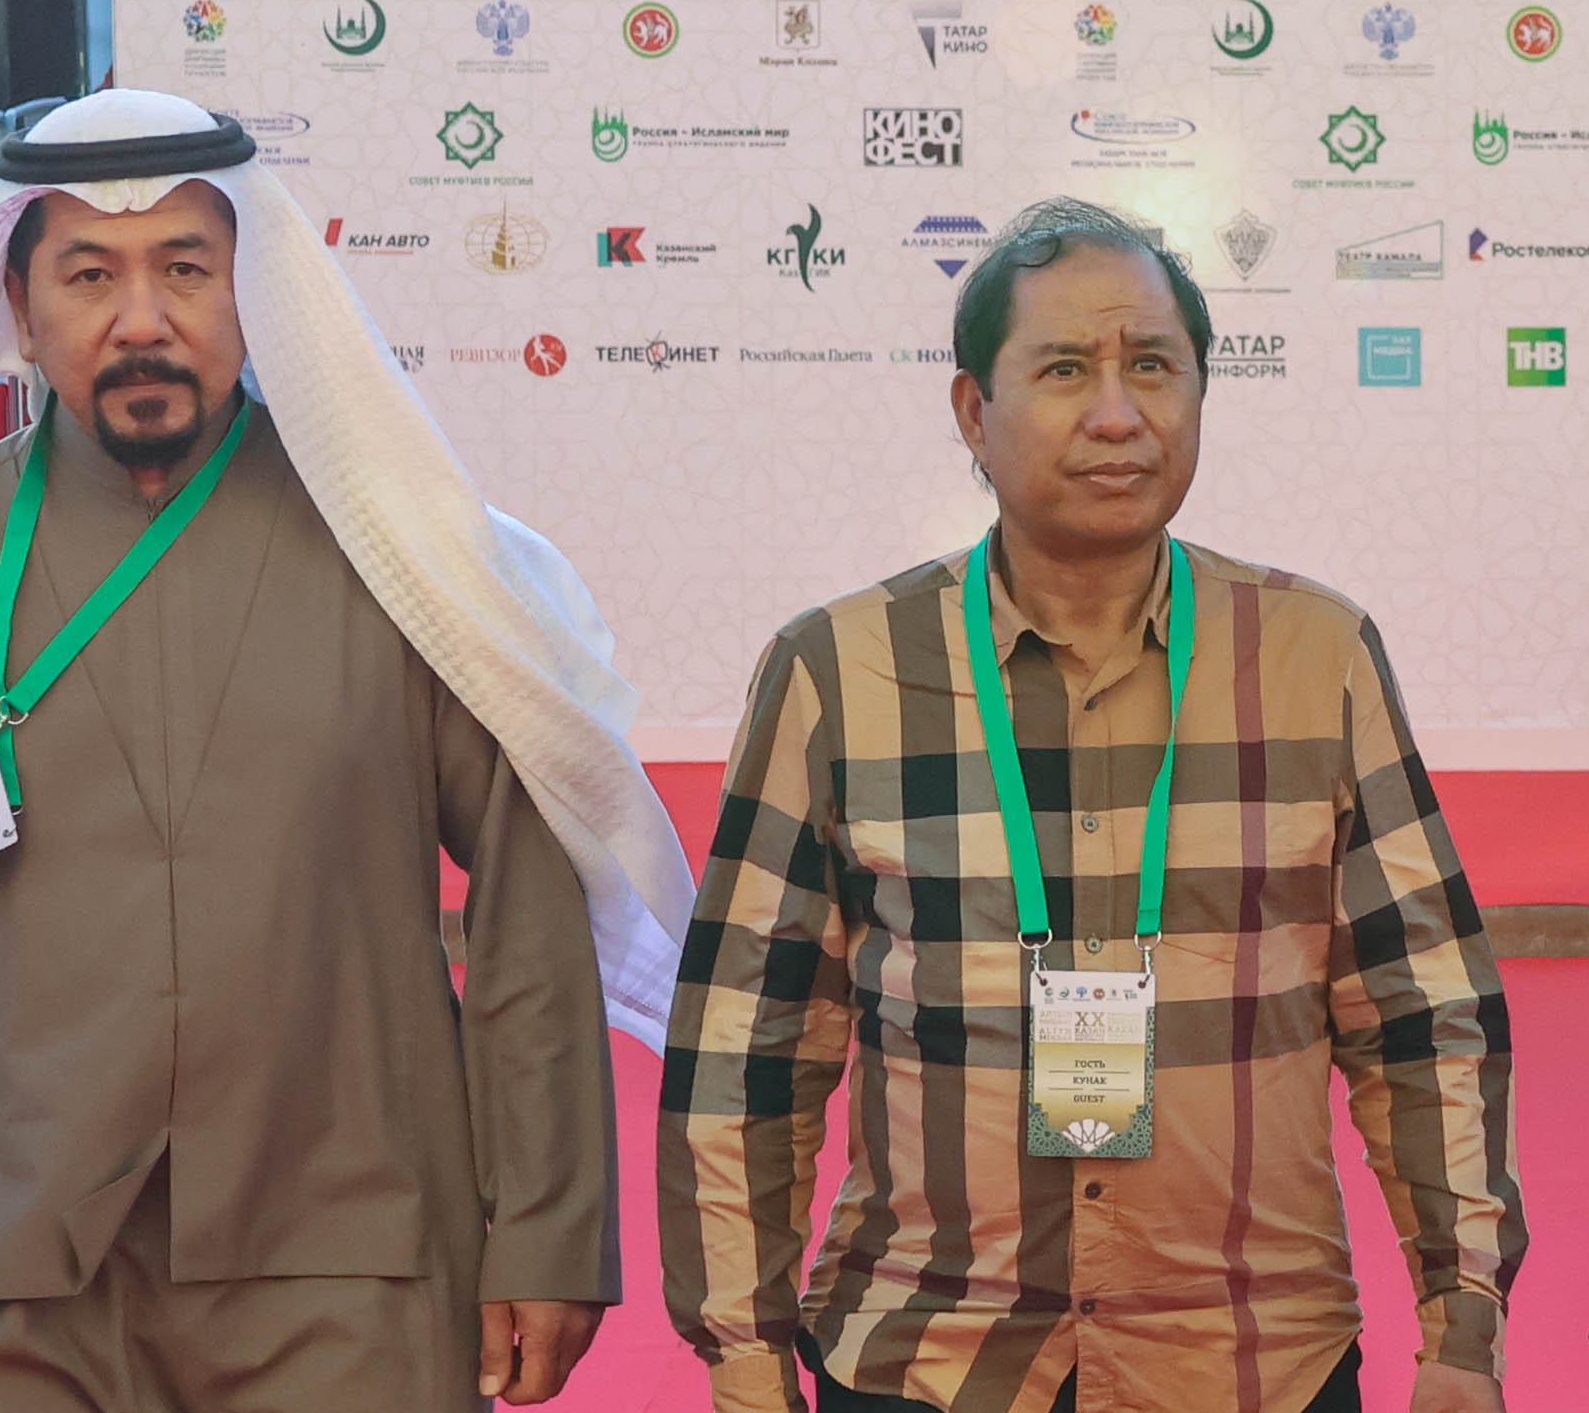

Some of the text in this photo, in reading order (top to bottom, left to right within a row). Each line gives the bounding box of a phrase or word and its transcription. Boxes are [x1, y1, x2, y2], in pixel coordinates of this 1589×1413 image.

[942, 25, 988, 37] ТАТАР
[943, 40, 989, 54] КИНО
[864, 109, 962, 138] КИНО
[632, 125, 790, 139] Россия Исламский мир
[1513, 130, 1553, 141] Россия
[864, 138, 961, 166] ФЕСТ
[347, 234, 430, 247] КАН АВТО
[655, 243, 717, 253] Казанский
[739, 348, 826, 363] Российская
[1507, 340, 1566, 372] ТНВ
[1074, 1060, 1106, 1069] ГОСТЬ
[1072, 1076, 1108, 1085] КУНАК
[1073, 1094, 1106, 1104] GUEST
